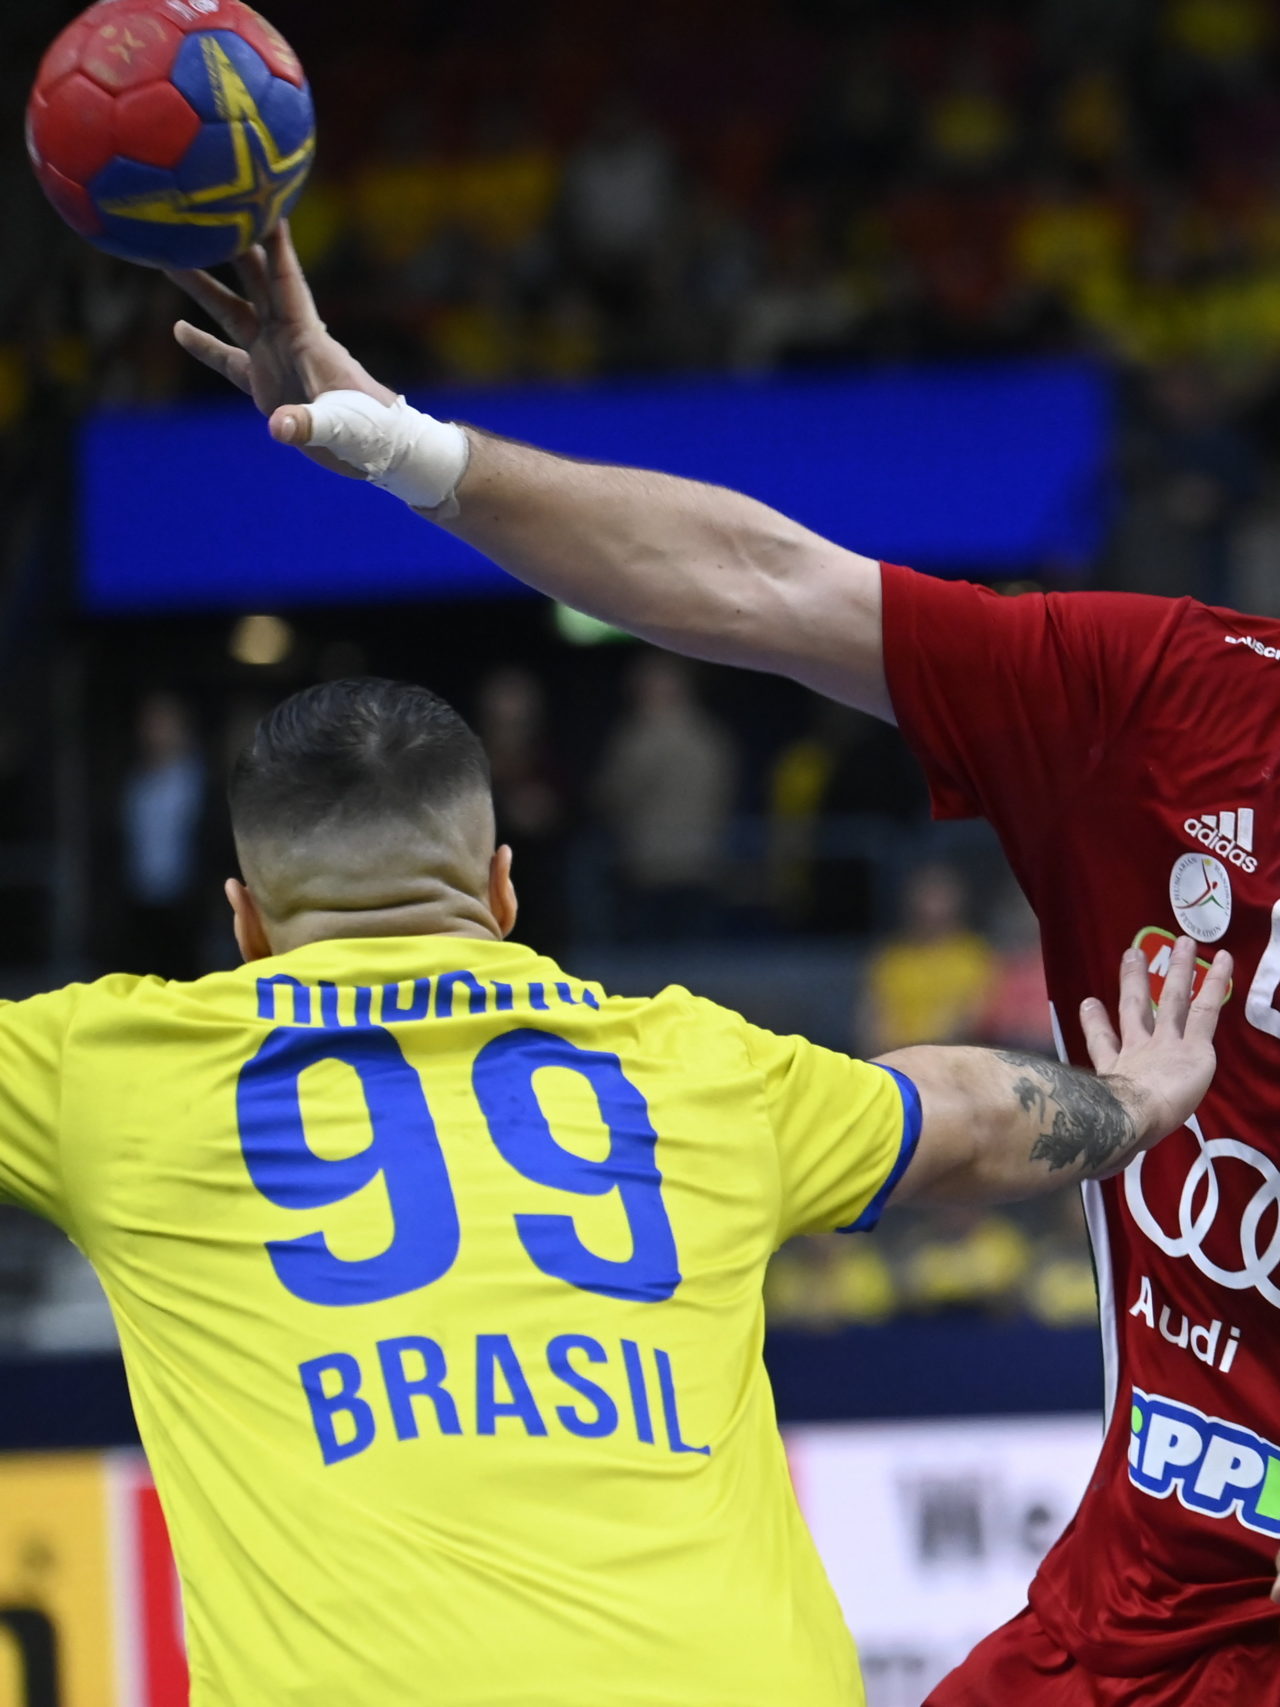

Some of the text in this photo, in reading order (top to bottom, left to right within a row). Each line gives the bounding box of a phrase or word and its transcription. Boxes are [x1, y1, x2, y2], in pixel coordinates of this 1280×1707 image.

[1184, 818, 1258, 873] adidas
[236, 1025, 683, 1307] 99
[1128, 1275, 1240, 1374] Audi
[299, 1332, 711, 1466] BRASIL
